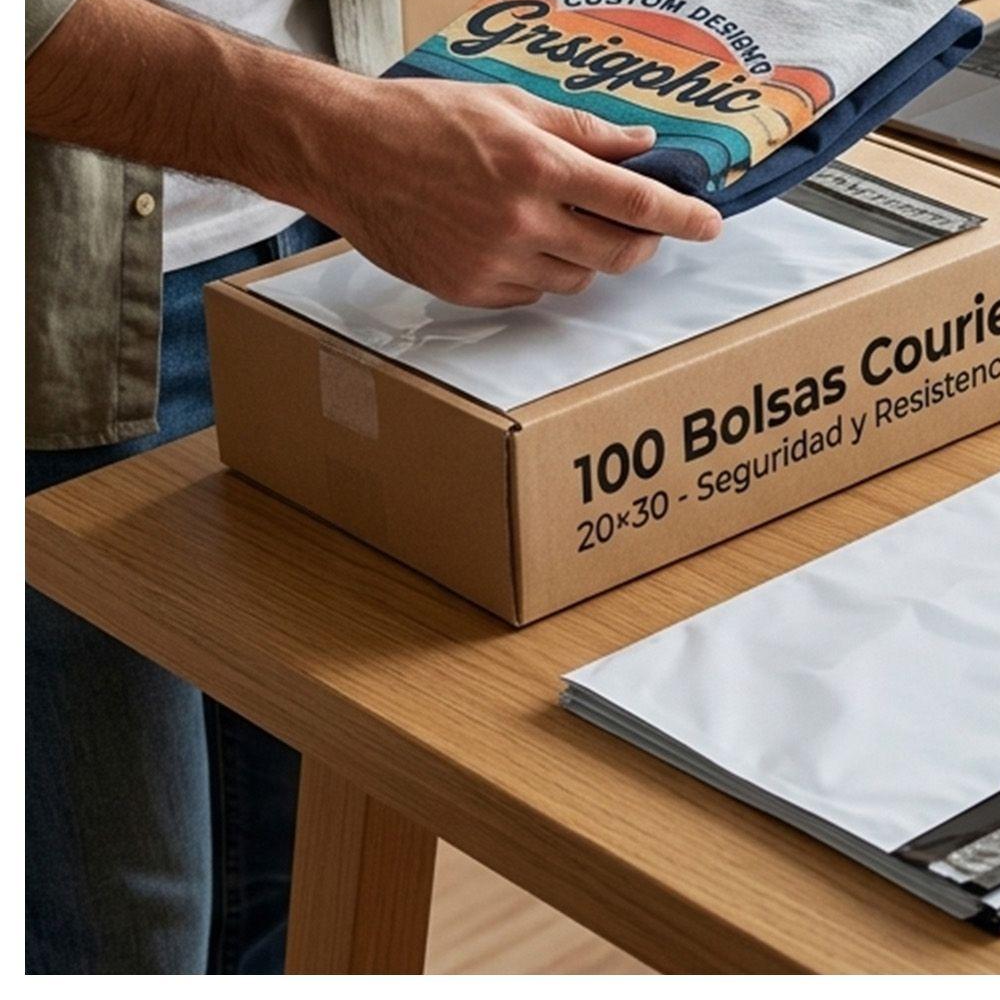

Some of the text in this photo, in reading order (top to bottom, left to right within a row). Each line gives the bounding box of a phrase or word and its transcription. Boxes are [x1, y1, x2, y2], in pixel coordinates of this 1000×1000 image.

[573, 428, 665, 505] 100
[683, 364, 846, 462] Bolsas
[697, 415, 843, 502] Seguridad
[850, 412, 868, 446] y
